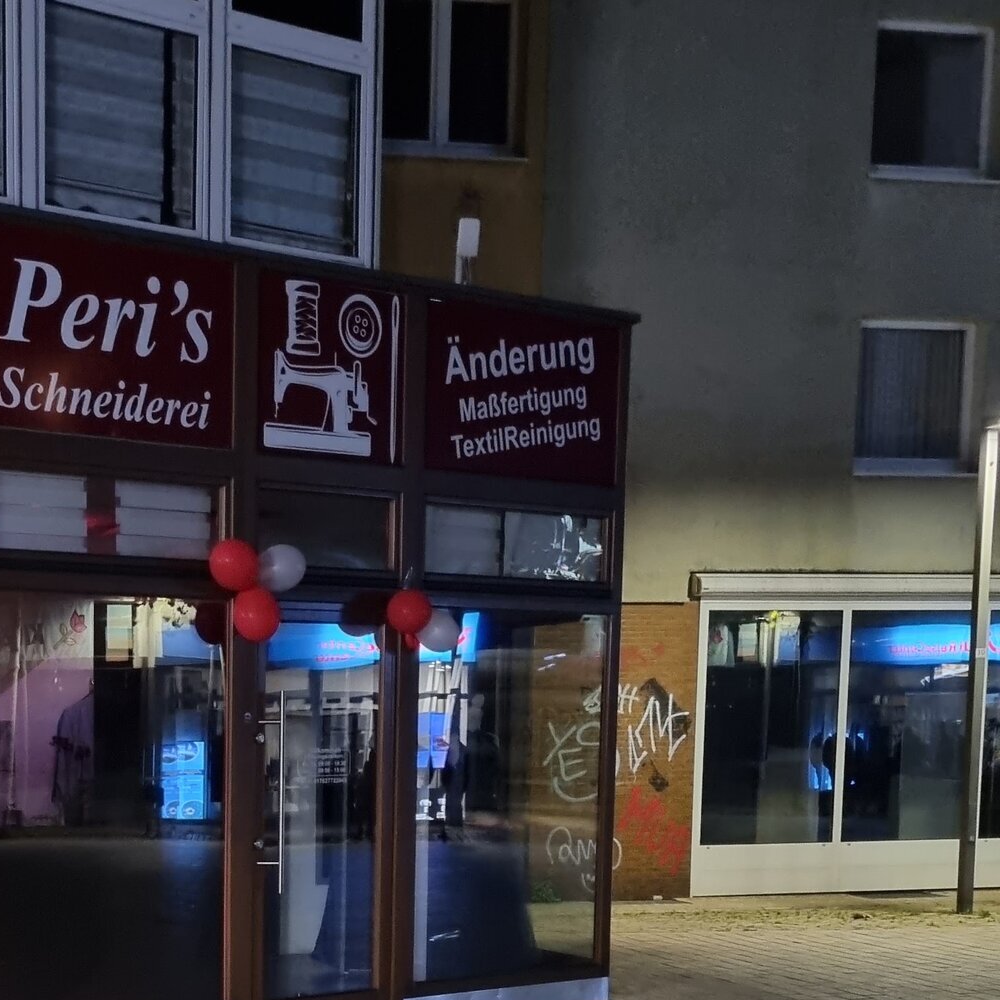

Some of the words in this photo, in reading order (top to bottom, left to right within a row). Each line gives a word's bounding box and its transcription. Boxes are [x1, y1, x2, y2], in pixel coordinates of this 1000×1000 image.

[0, 258, 213, 364] Peri's
[445, 336, 596, 385] Änderung
[458, 383, 588, 423] Maßfertigung
[450, 415, 602, 460] TextilReinigung
